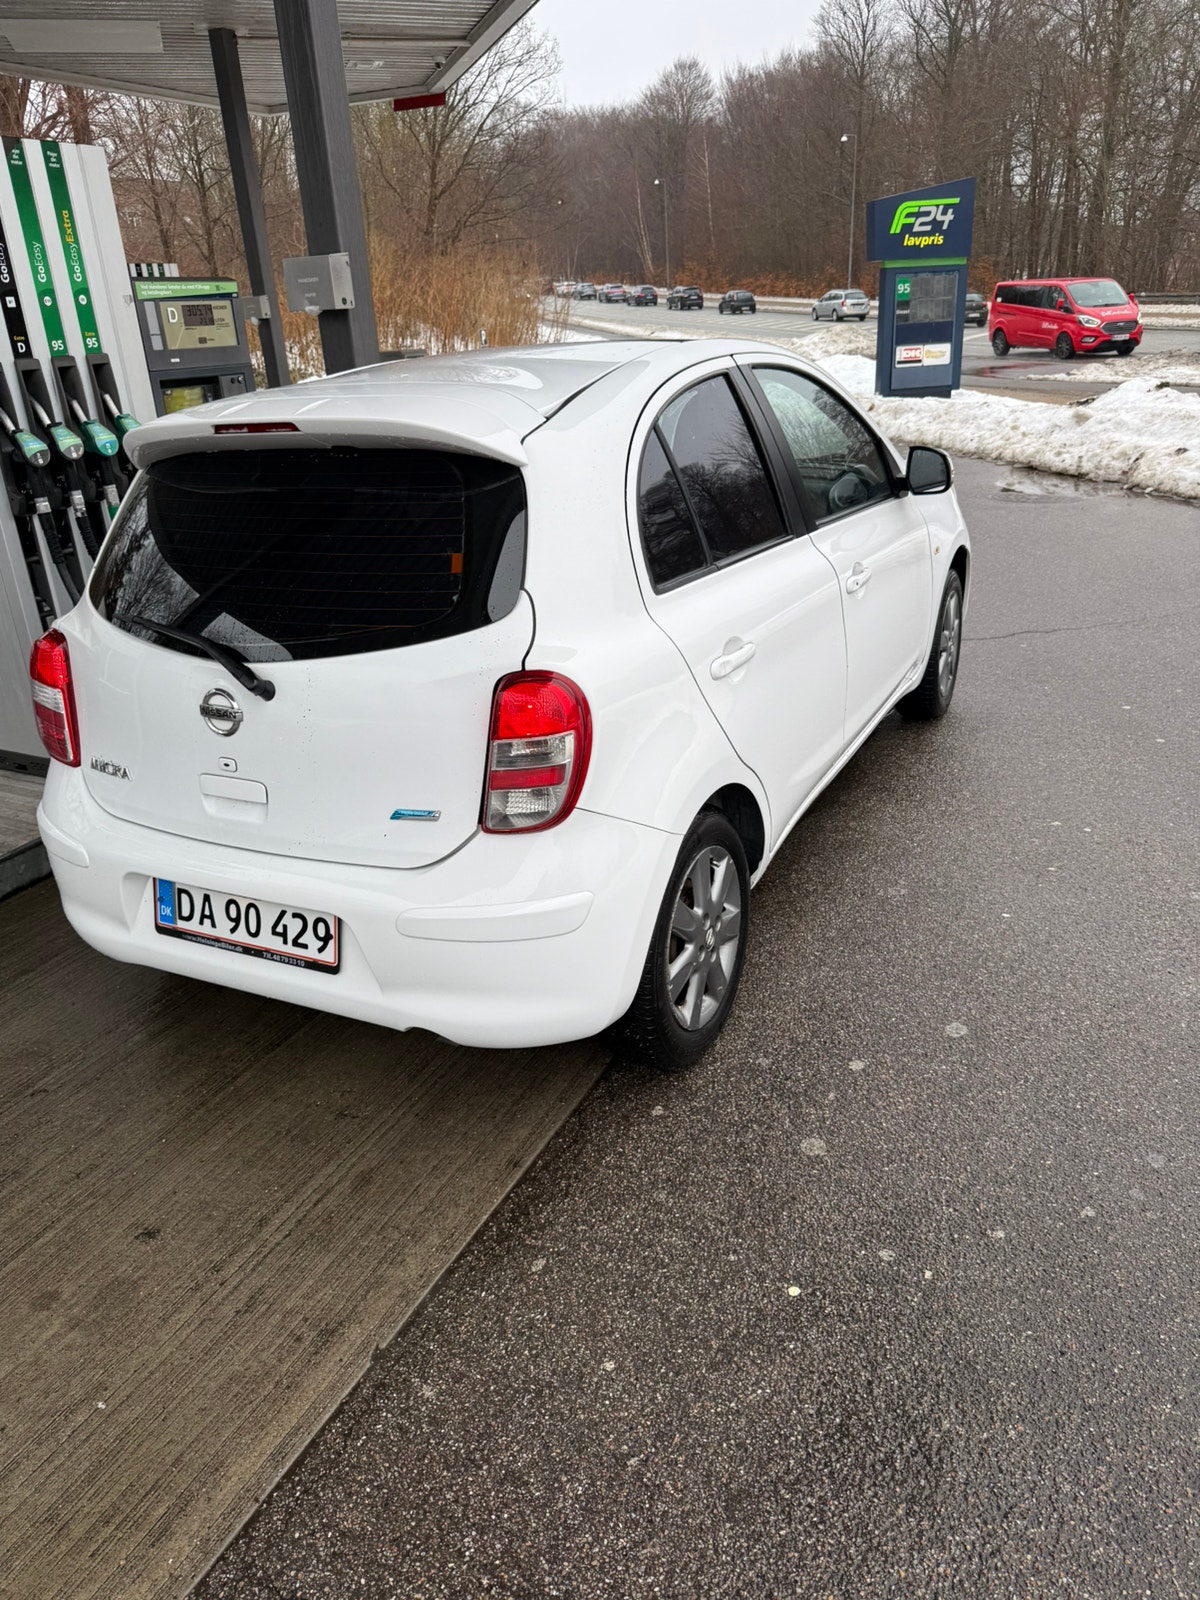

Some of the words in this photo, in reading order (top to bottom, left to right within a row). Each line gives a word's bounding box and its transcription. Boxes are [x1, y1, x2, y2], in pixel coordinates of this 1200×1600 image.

[889, 198, 960, 234] F24
[903, 233, 944, 248] lavpris
[33, 241, 46, 283] GoEasy
[897, 283, 911, 294] 95
[167, 307, 178, 323] D
[17, 342, 26, 353] D
[51, 340, 64, 351] 95
[86, 338, 99, 348] 95
[201, 705, 237, 719] NISSAN
[161, 905, 172, 917] DK
[177, 887, 217, 929] DA
[224, 898, 262, 938] 90
[271, 909, 331, 954] 429
